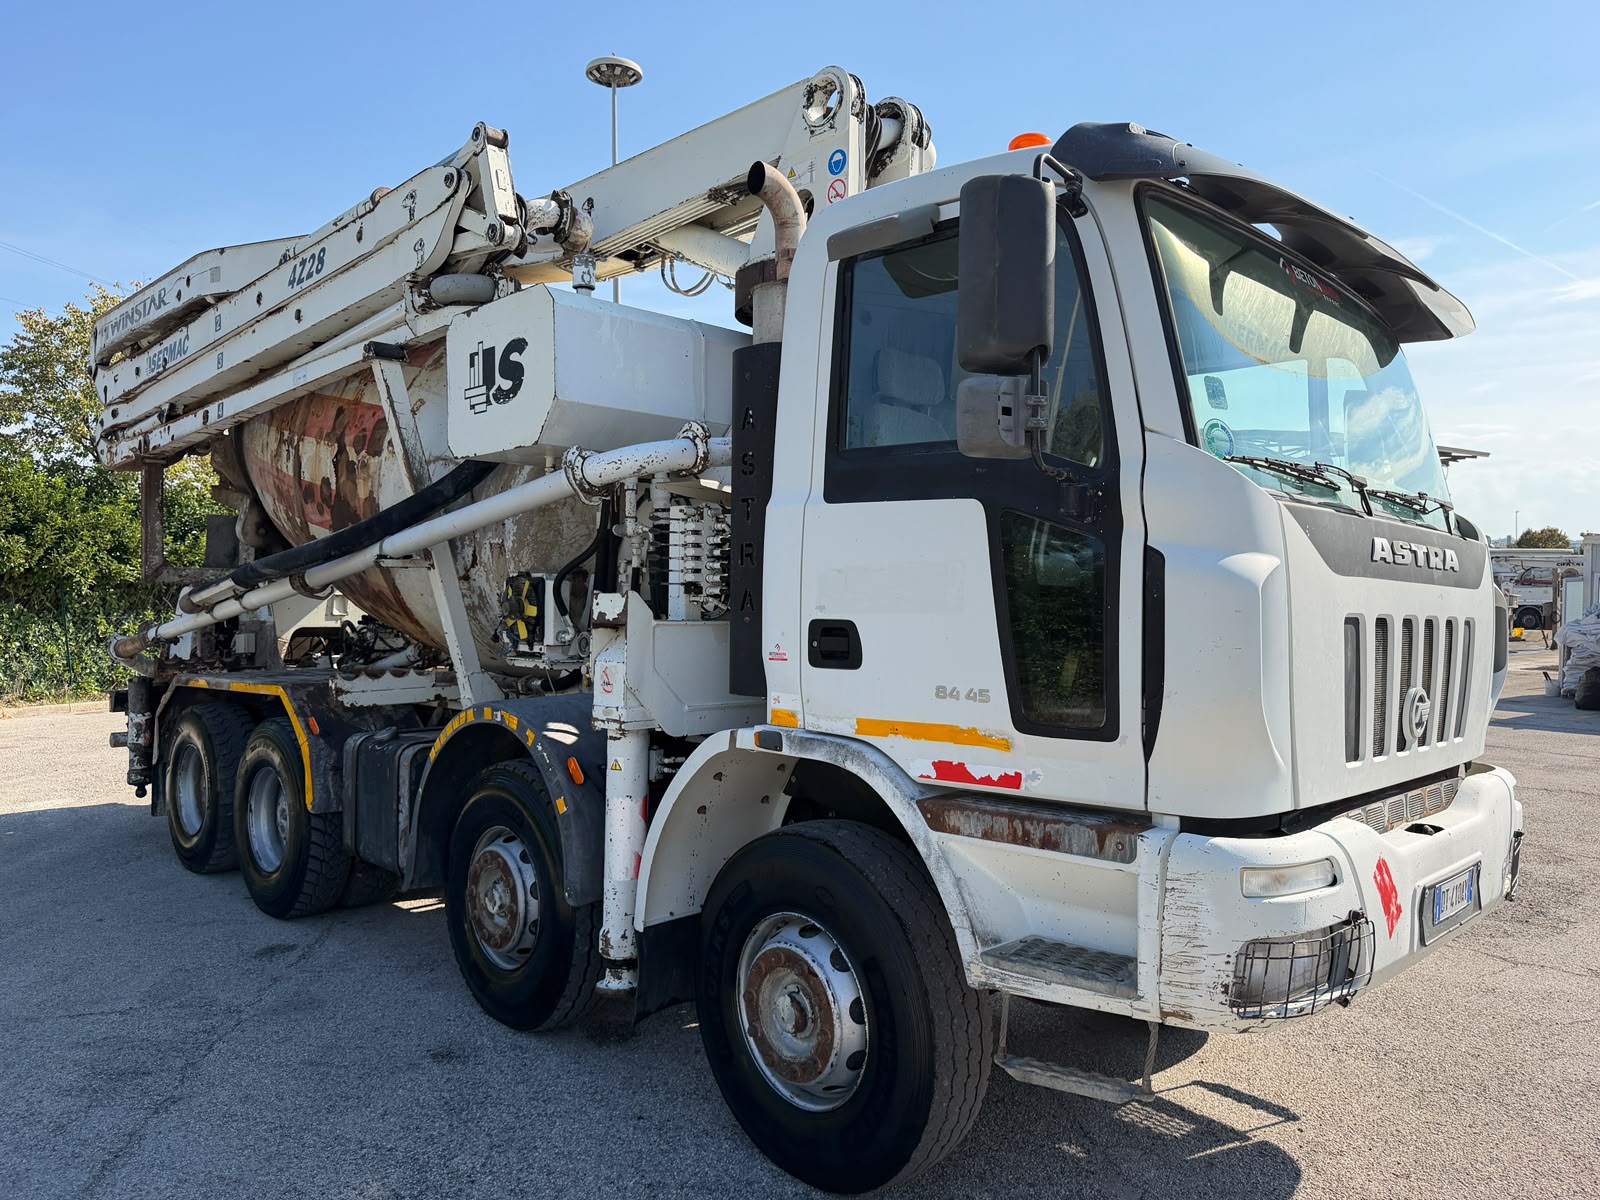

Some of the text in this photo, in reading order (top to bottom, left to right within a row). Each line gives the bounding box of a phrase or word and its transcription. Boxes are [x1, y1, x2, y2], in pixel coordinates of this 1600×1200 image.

[288, 246, 326, 289] 4Z28
[100, 287, 170, 341] TWINSTAR
[740, 405, 756, 613] ASTRA
[1371, 536, 1460, 573] ASTRA
[935, 685, 991, 703] 84 45
